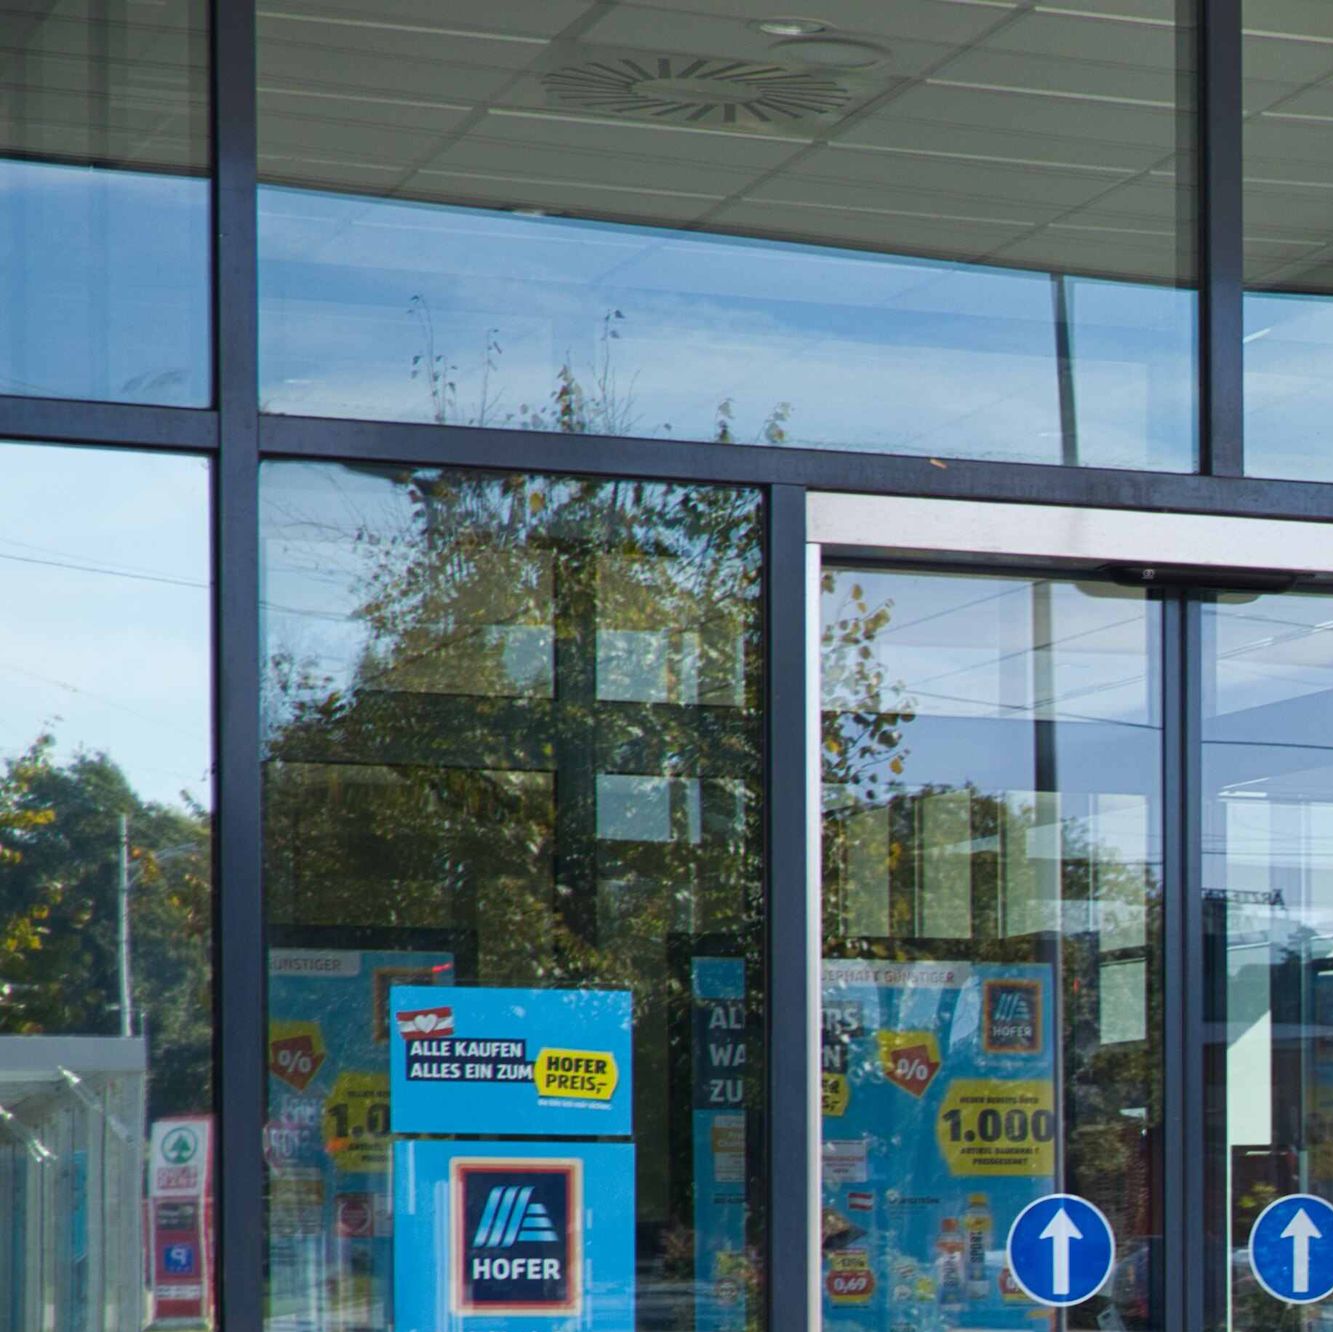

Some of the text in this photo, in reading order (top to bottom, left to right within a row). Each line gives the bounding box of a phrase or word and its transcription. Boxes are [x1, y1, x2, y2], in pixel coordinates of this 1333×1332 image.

[992, 1024, 1032, 1038] HOFER
[410, 1040, 522, 1057] ALLE KAUFEN
[410, 1062, 534, 1080] ALLES EIN ZUM
[546, 1056, 607, 1075] HOFER
[545, 1074, 607, 1094] PREIS,-
[942, 1108, 1056, 1143] 1.000
[472, 1257, 561, 1280] HOFER
